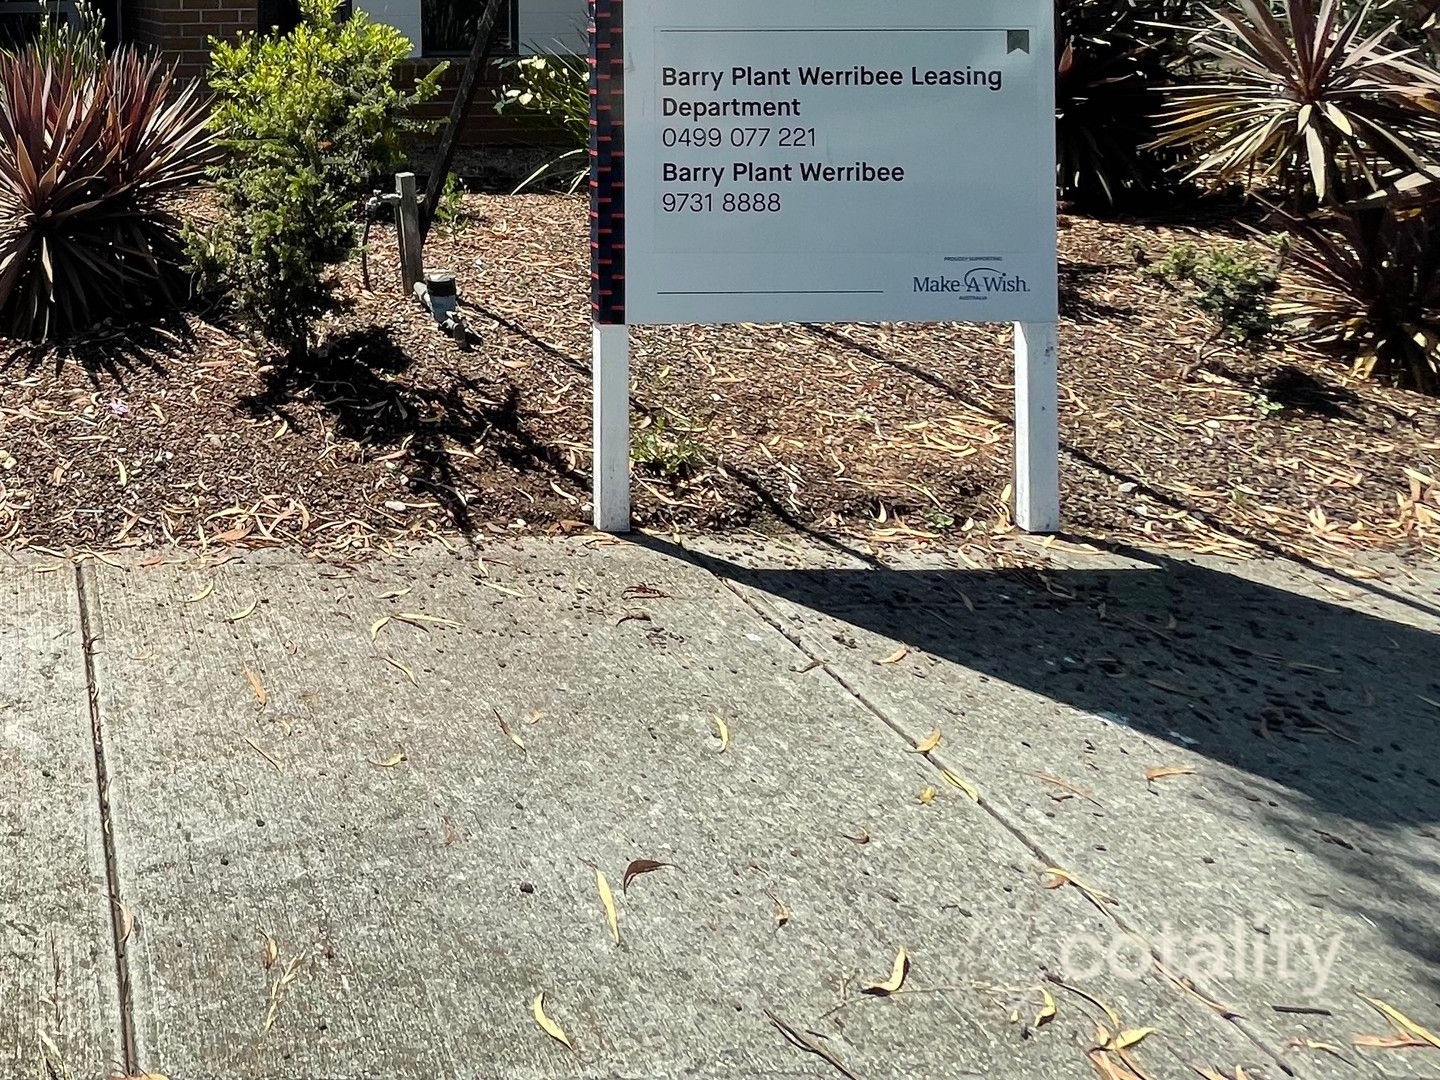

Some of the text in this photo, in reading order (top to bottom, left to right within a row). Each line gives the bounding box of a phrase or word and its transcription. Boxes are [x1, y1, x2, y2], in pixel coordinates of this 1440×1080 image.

[662, 66, 1002, 91] Barry Plant Werribee Leasing
[662, 97, 801, 121] Department
[662, 127, 816, 148] 0499 077 221
[663, 162, 905, 187] Barry Plant Werribee
[662, 193, 781, 213] 9731 8888
